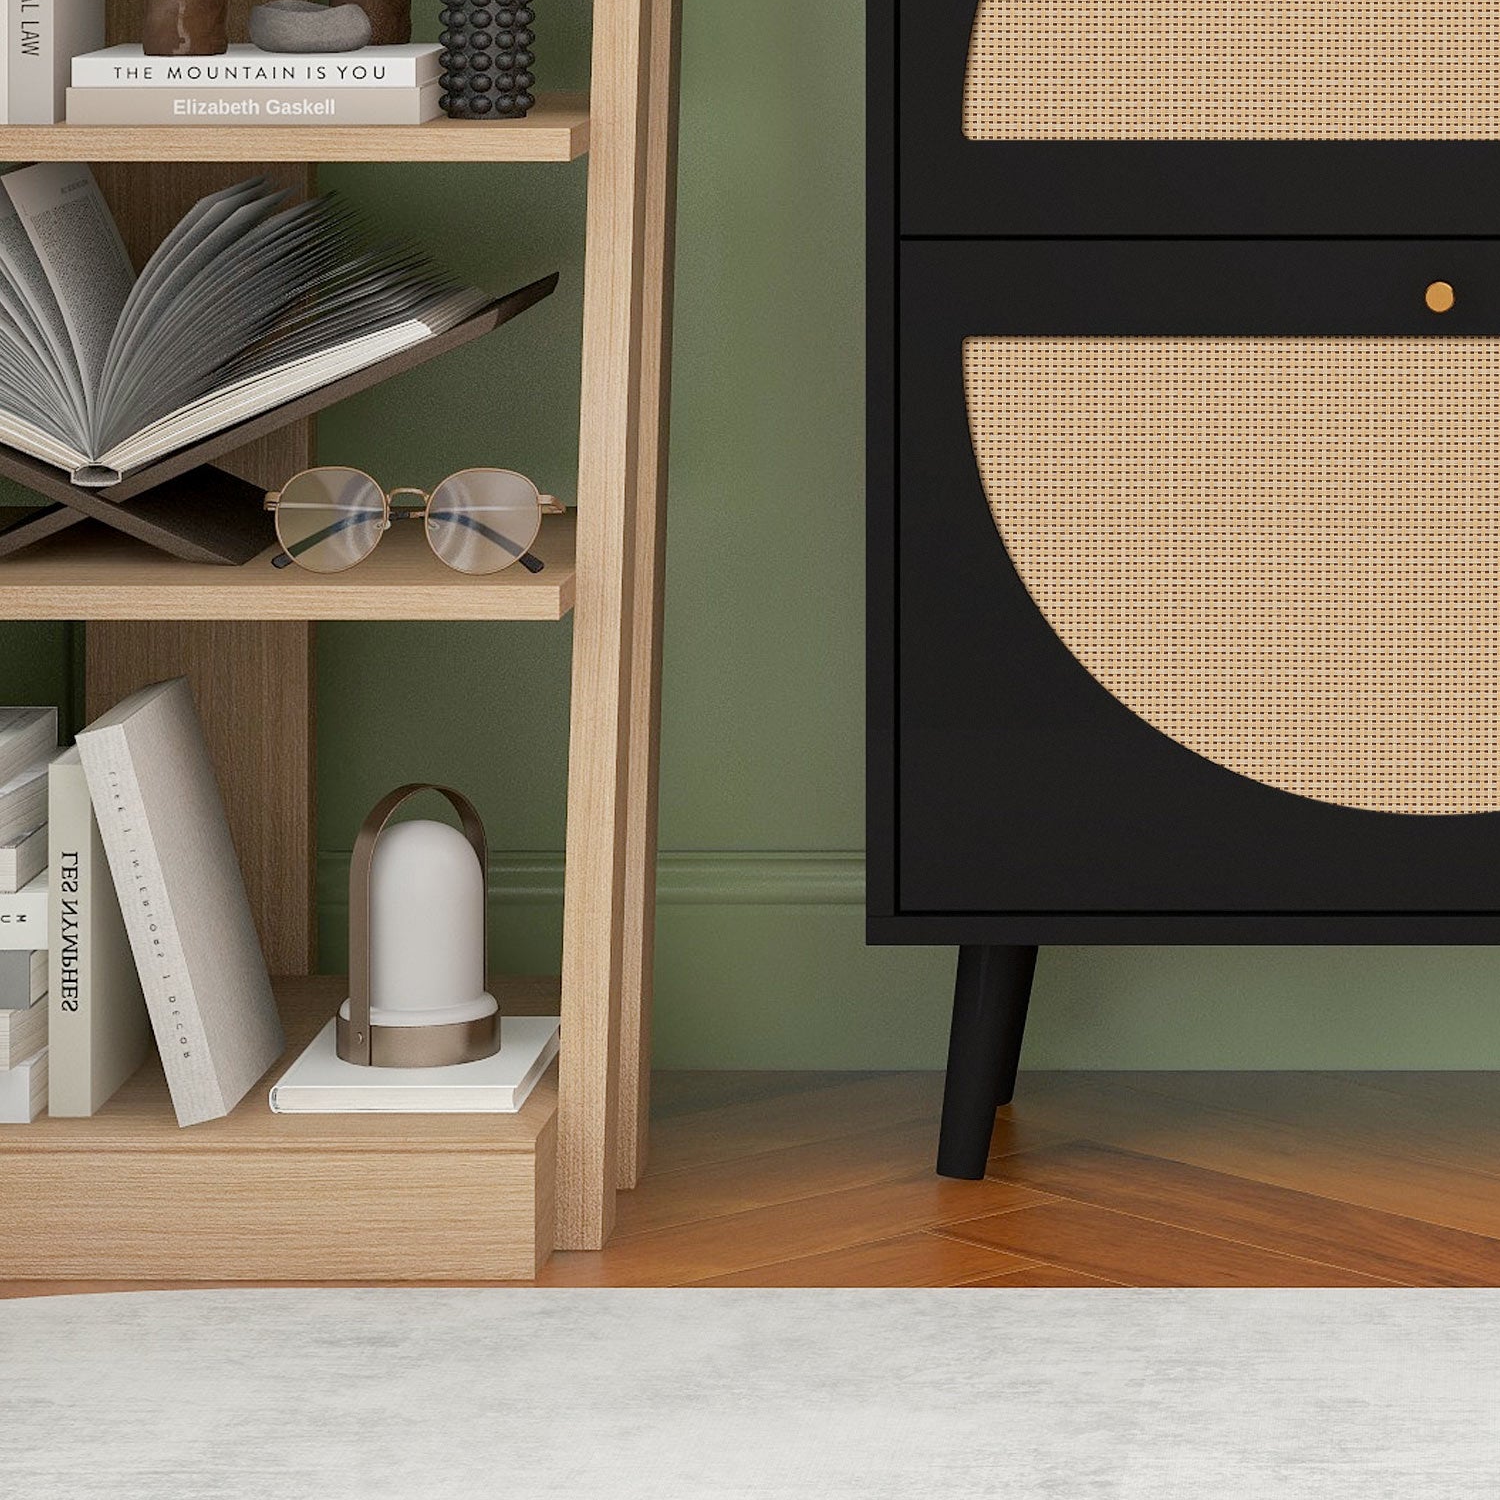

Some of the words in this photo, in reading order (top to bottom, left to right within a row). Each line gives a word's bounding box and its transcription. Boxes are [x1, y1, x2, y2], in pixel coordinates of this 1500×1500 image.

[20, 21, 40, 56] LAW
[114, 66, 153, 80] THE
[167, 65, 296, 80] MOUNTAIN
[306, 66, 327, 80] IS
[336, 65, 387, 80] YOU
[172, 98, 261, 116] Elizabeth
[265, 98, 336, 116] Gaskell
